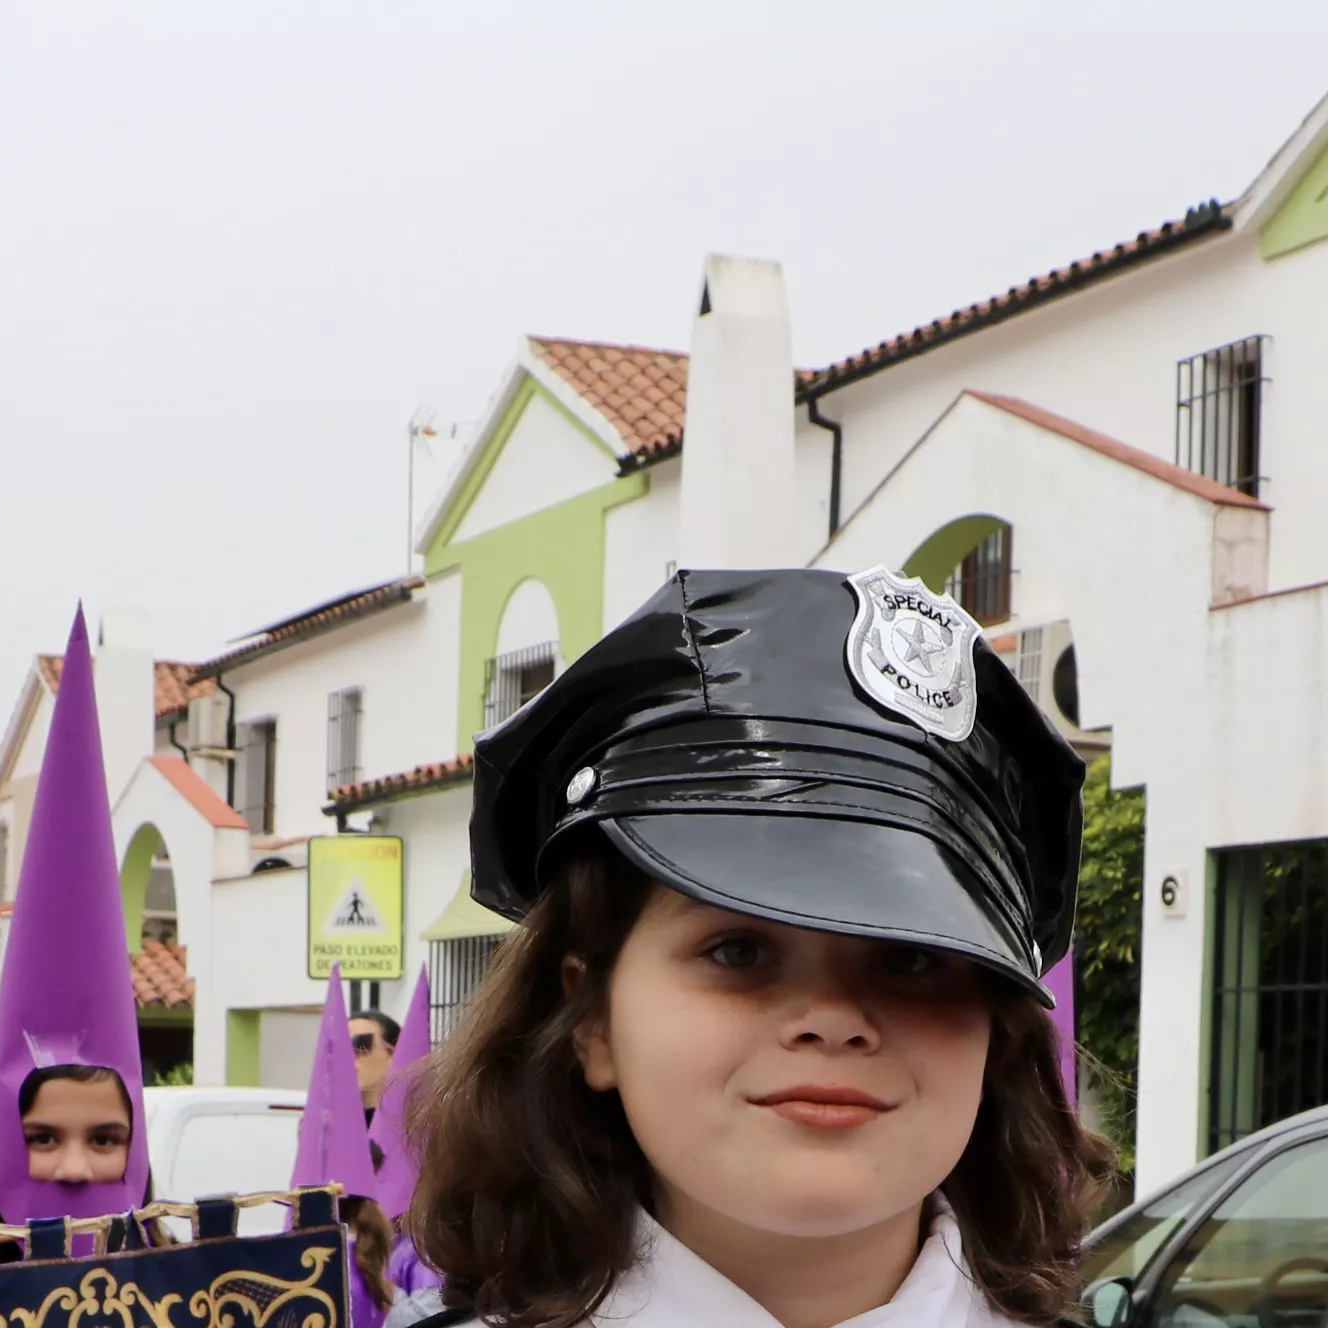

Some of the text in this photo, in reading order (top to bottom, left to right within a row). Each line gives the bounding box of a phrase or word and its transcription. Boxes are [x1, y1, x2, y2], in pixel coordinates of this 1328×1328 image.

[883, 594, 953, 631] SPECIAL
[881, 663, 954, 709] POLICE
[1161, 876, 1178, 906] 6
[313, 944, 398, 956] PASO ELEVADO
[316, 960, 329, 971] DE
